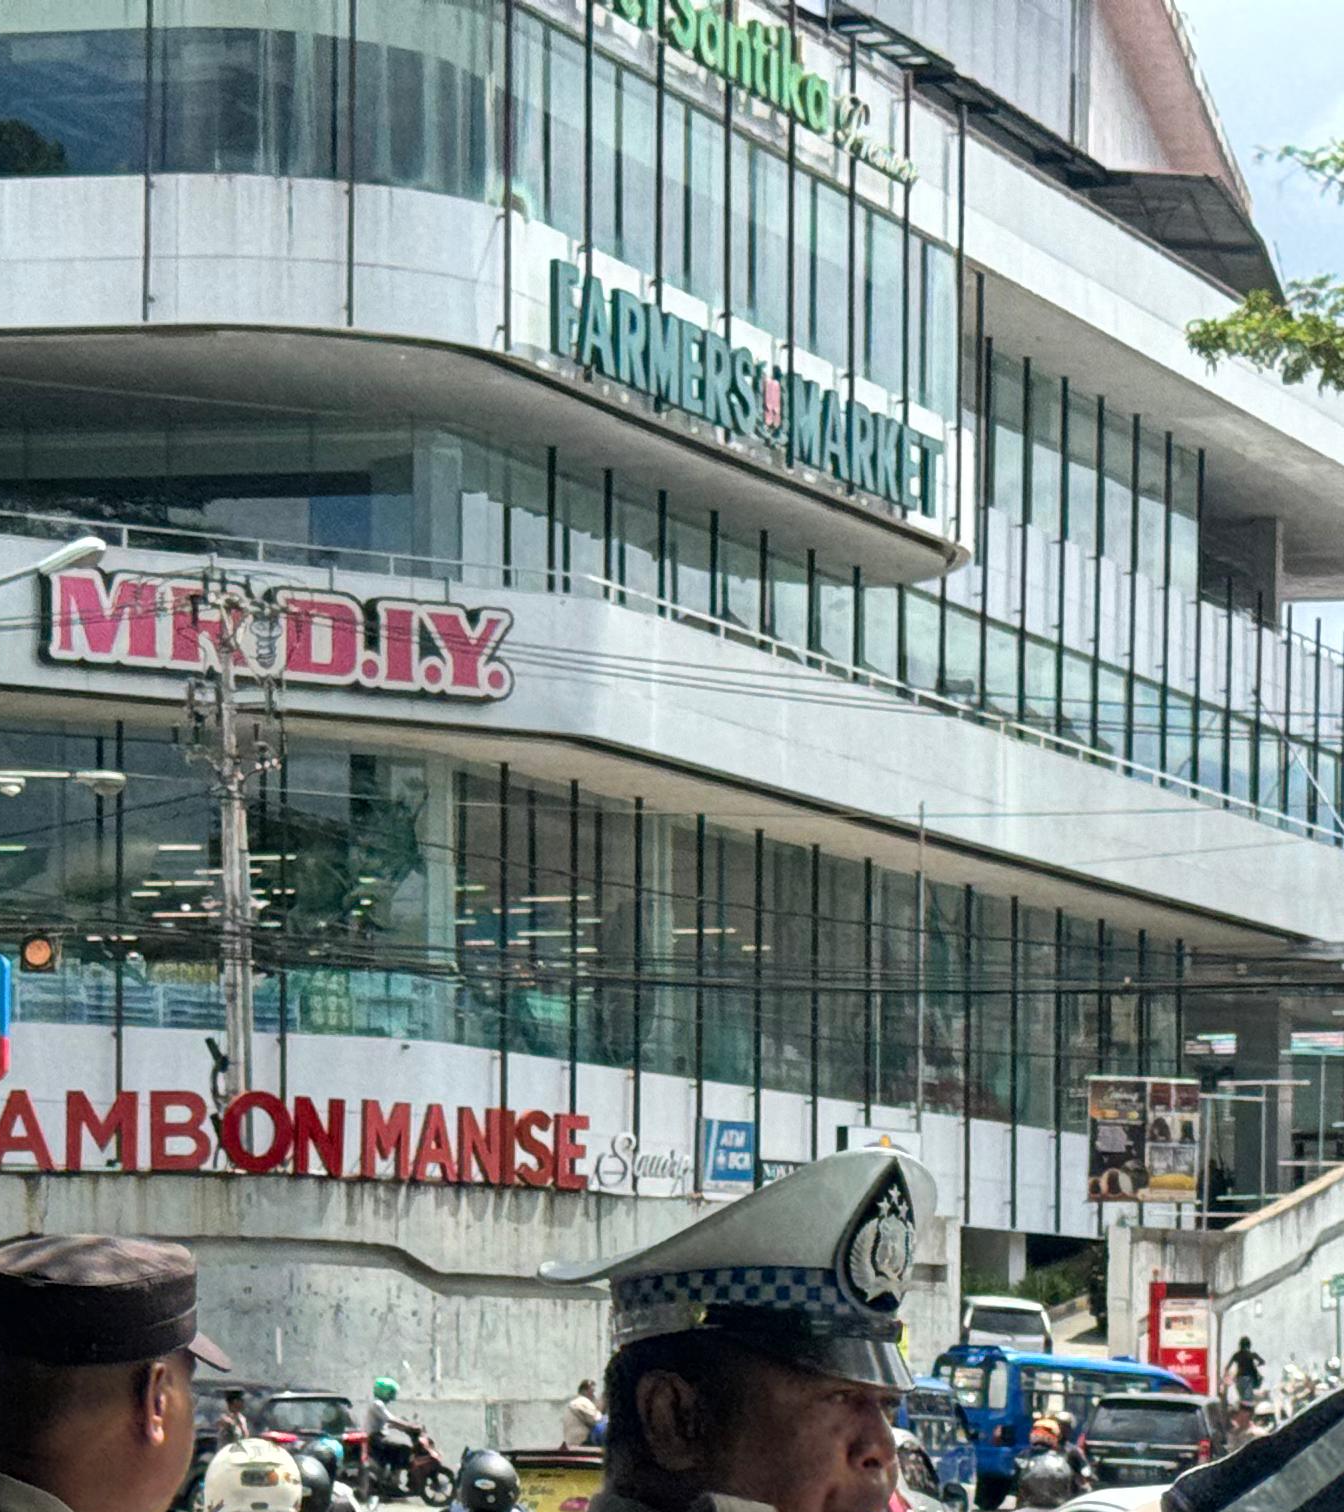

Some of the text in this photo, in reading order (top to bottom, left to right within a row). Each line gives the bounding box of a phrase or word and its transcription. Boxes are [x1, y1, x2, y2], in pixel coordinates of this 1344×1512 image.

[550, 258, 946, 518] FARMERS MARKET
[359, 1097, 591, 1191] MANISE
